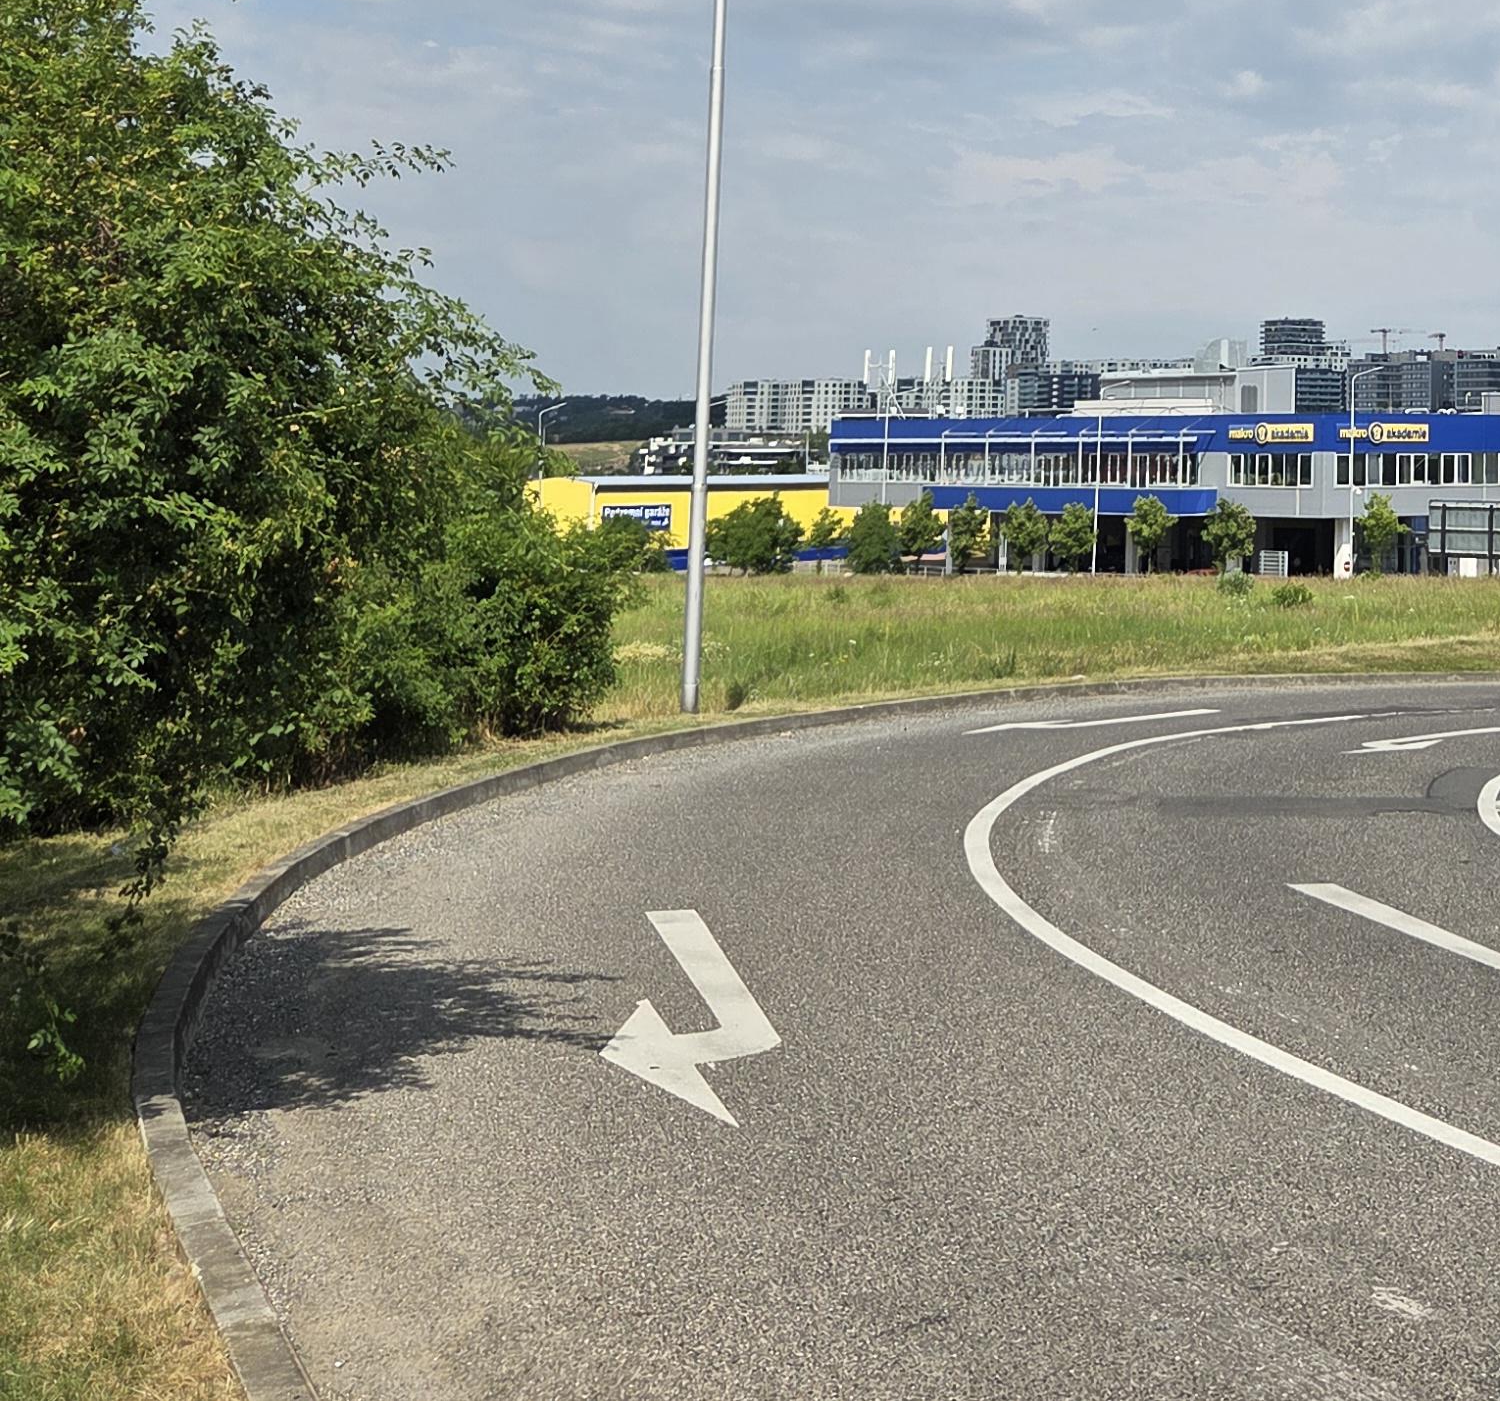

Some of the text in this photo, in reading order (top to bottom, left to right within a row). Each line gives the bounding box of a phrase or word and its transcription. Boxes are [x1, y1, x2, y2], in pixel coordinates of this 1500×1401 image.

[1228, 427, 1310, 440] makro akademie
[1339, 426, 1427, 440] makro akademie
